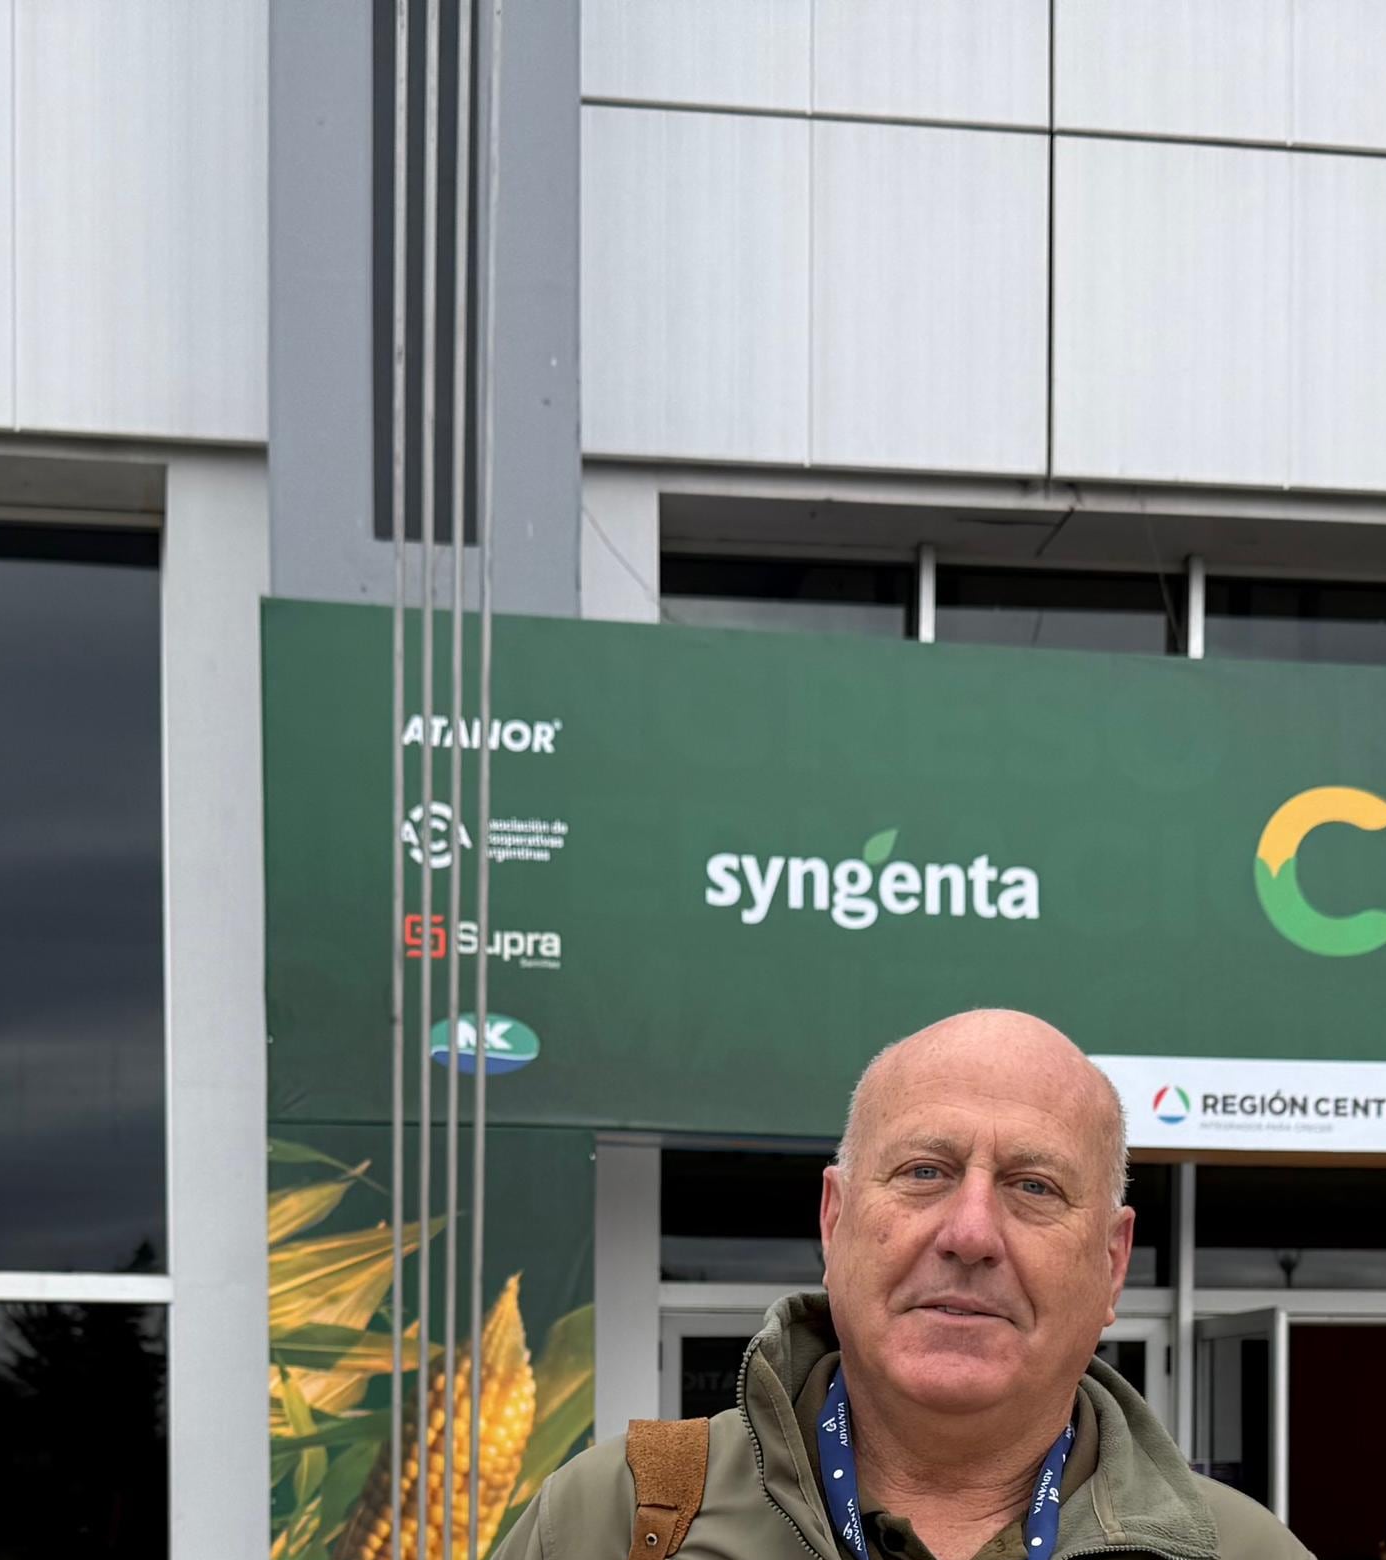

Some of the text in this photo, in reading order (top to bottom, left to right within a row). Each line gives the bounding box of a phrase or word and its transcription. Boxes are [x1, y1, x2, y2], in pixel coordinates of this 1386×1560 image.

[489, 817, 550, 833] sociación
[489, 832, 564, 849] ooperativas
[488, 847, 551, 863] rgentinas
[705, 853, 1040, 929] syngenta
[457, 921, 562, 961] Supra
[1201, 1090, 1308, 1117] REGIÓN
[1033, 1468, 1054, 1514] ADVANTA
